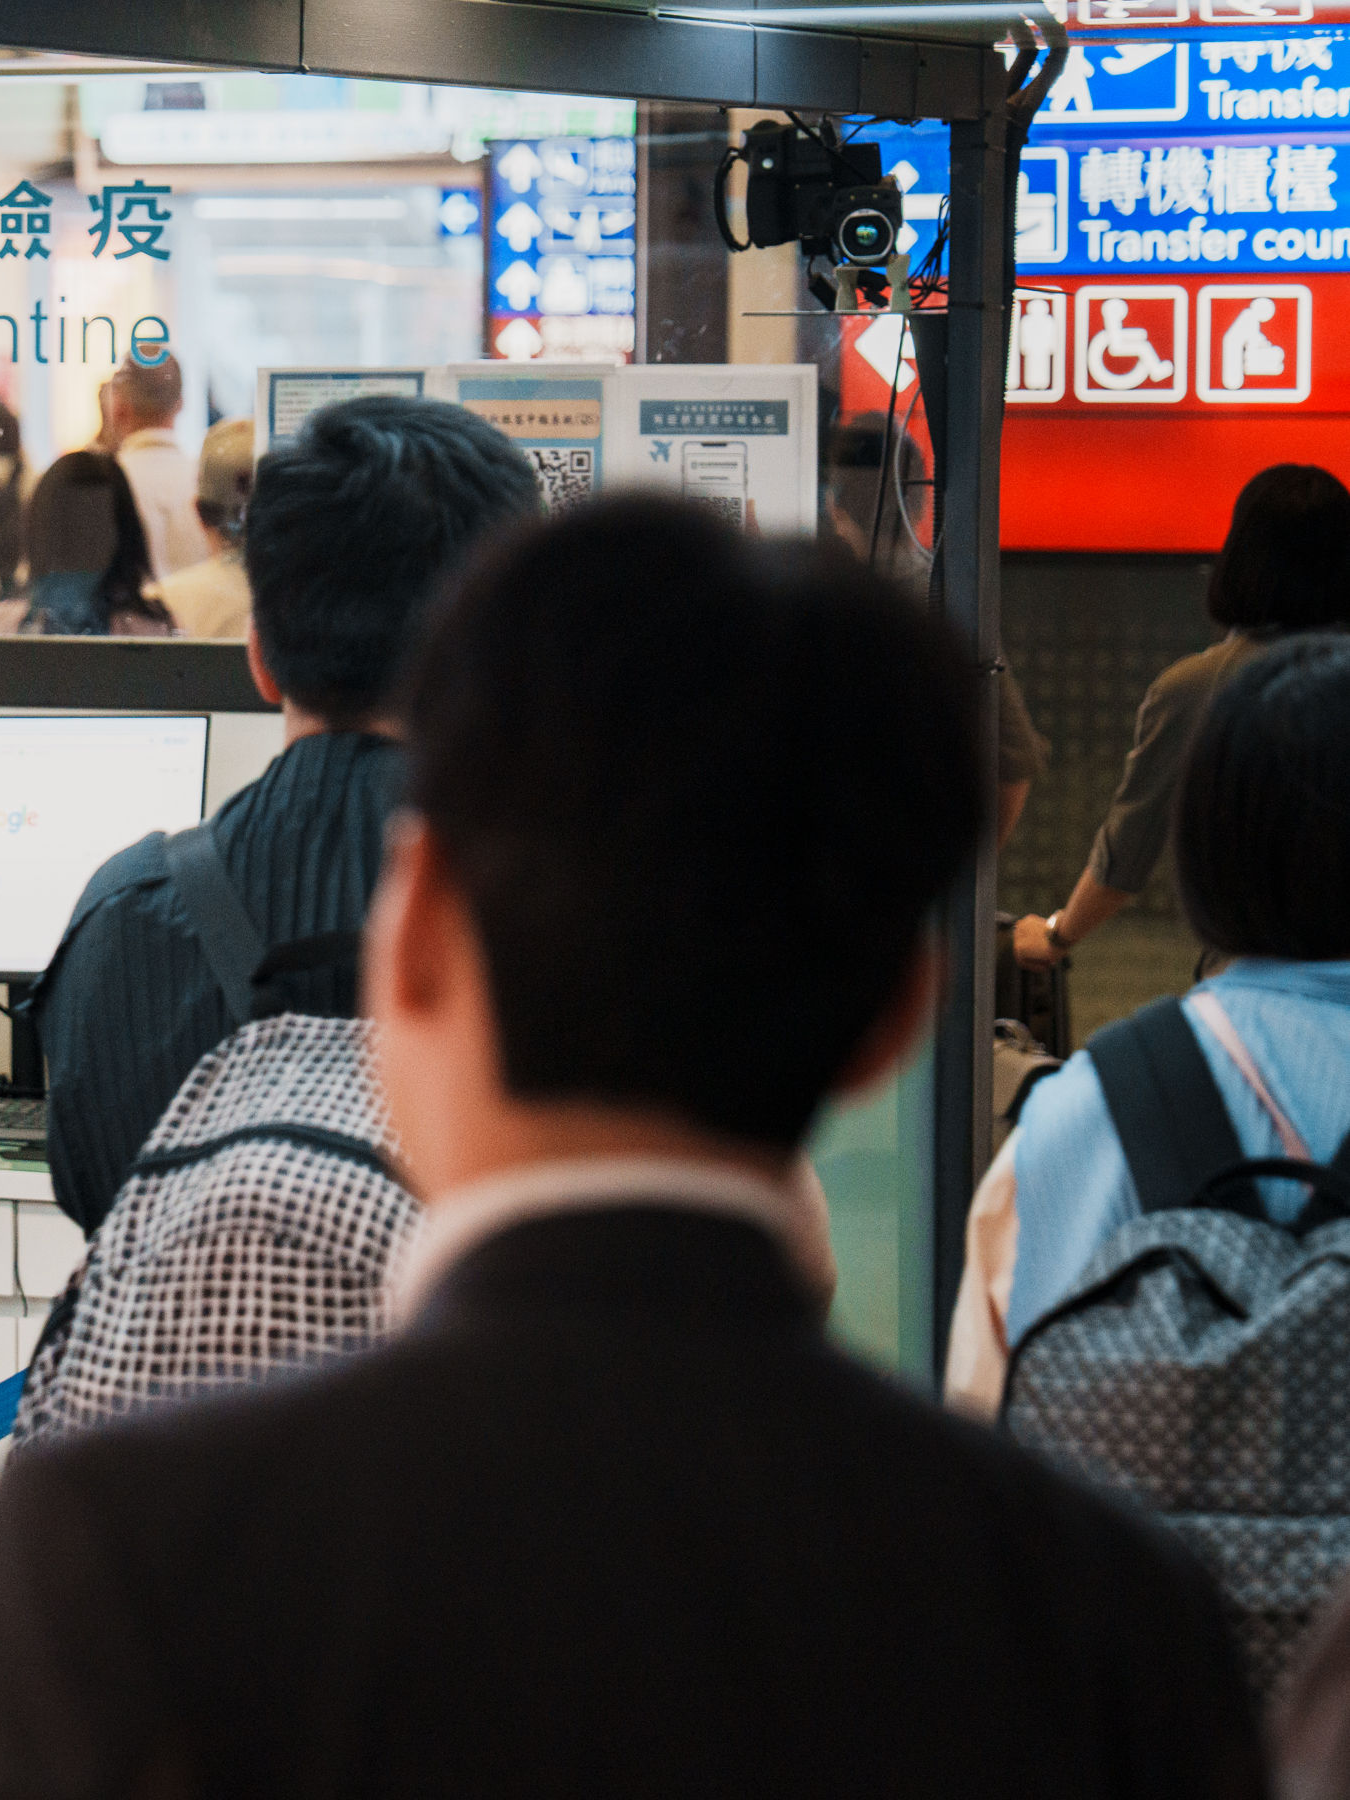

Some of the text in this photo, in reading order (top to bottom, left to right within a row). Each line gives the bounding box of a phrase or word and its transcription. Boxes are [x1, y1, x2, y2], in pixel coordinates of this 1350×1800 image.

[1199, 75, 1350, 120] Transfer
[1078, 216, 1350, 262] Transfer coun
